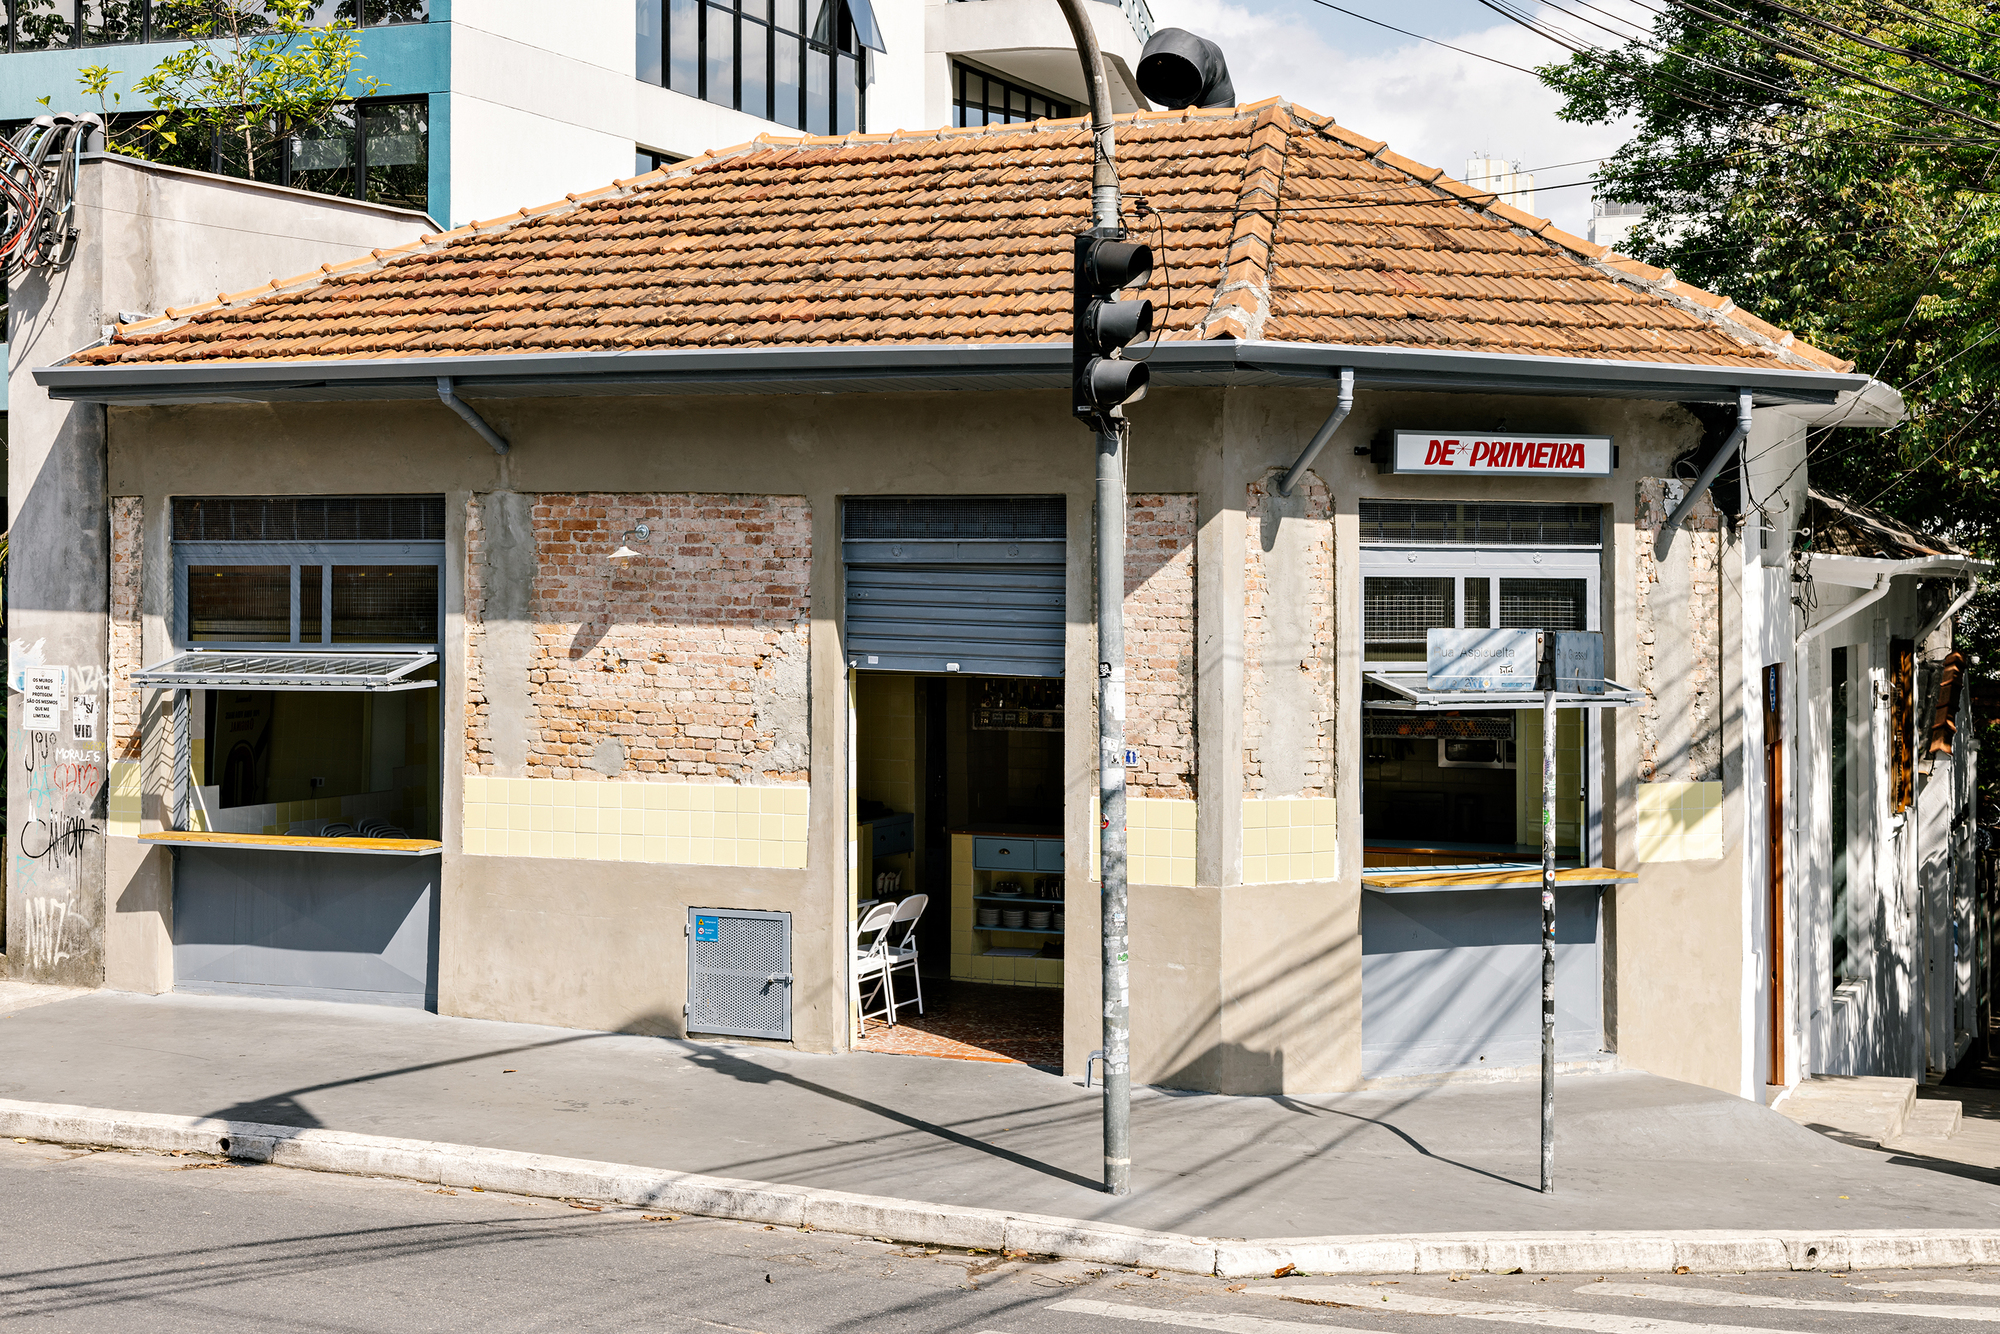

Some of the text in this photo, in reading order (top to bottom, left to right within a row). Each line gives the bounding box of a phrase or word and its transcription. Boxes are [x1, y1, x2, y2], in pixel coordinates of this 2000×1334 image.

[1424, 439, 1585, 469] DE PRIMEIRA
[1433, 646, 1515, 660] Rua Aspicuelta
[55, 747, 100, 763] MORALES
